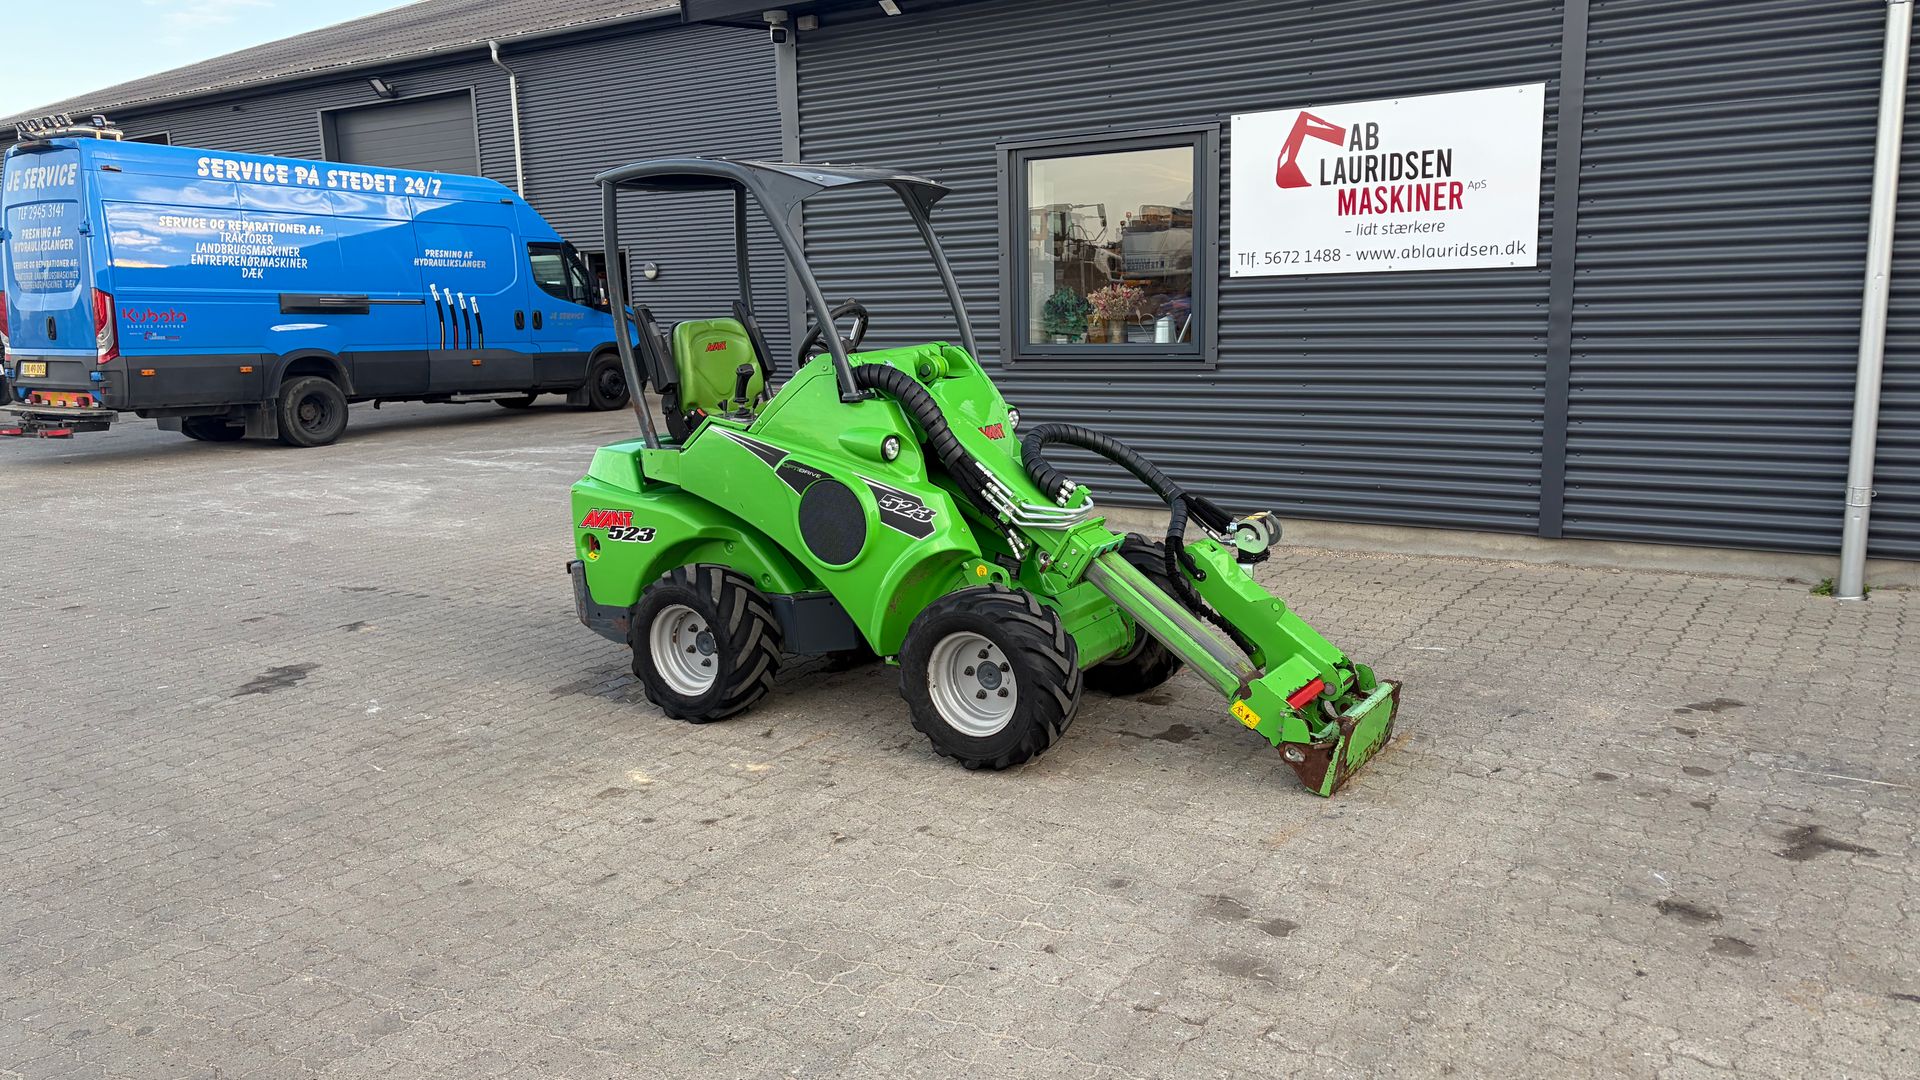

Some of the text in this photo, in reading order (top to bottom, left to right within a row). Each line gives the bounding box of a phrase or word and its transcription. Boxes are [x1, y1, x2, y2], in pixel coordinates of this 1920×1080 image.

[1349, 122, 1379, 152] AB
[1320, 148, 1452, 186] LAURIDSEN
[6, 163, 77, 192] JE SERVICE
[197, 157, 442, 197] SERVICE PÅ STEDET 24/7
[1338, 179, 1487, 216] MASKINER ApS
[18, 207, 27, 221] TLF
[21, 226, 62, 240] PRESNING AF
[159, 215, 324, 235] SERVICE OG REPARATIONER AF:
[1356, 223, 1378, 236] lidt
[1382, 221, 1446, 235] stærkere
[219, 231, 274, 245] TRAKTORER
[195, 242, 301, 258] LANDBRUGSMASKINER
[424, 249, 474, 259] PRESNING AF
[1238, 252, 1260, 268] Tlf.
[1264, 250, 1300, 264] 5672
[1304, 248, 1342, 263] 1488
[1356, 240, 1527, 261] www.ablauridsen.dk
[191, 254, 309, 270] ENTREPRENØRMASKINER
[414, 258, 487, 269] HYDRAULIKSLANGER
[242, 268, 264, 279] DÆK
[122, 308, 187, 323] Kubota
[878, 493, 937, 523] 523
[578, 508, 634, 529] AVANT
[607, 525, 657, 543] 523
